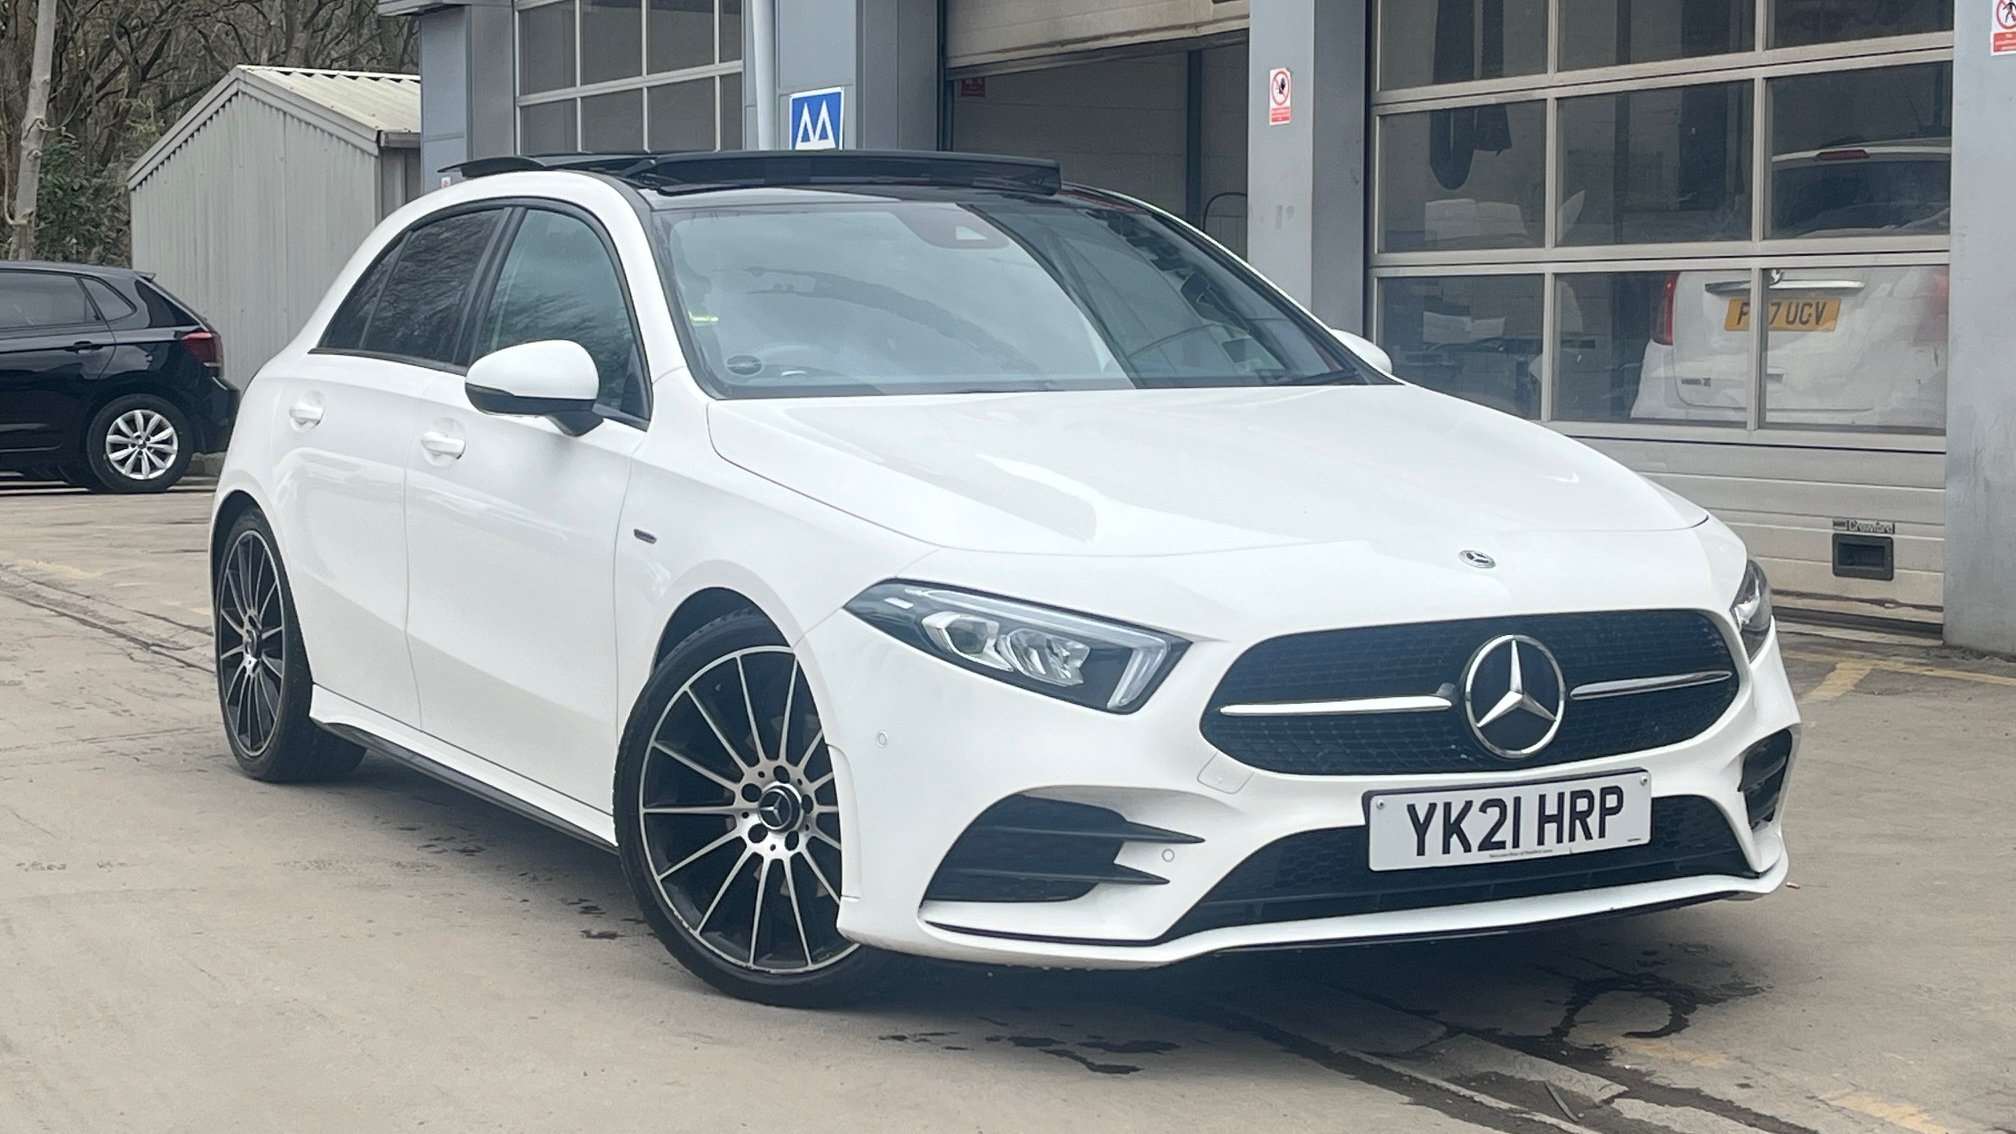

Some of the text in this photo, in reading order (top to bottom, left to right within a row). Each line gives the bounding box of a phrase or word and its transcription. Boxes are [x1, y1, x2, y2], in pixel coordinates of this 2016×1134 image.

[1785, 301, 1826, 326] UGV
[1406, 785, 1624, 857] YK21 HRP
